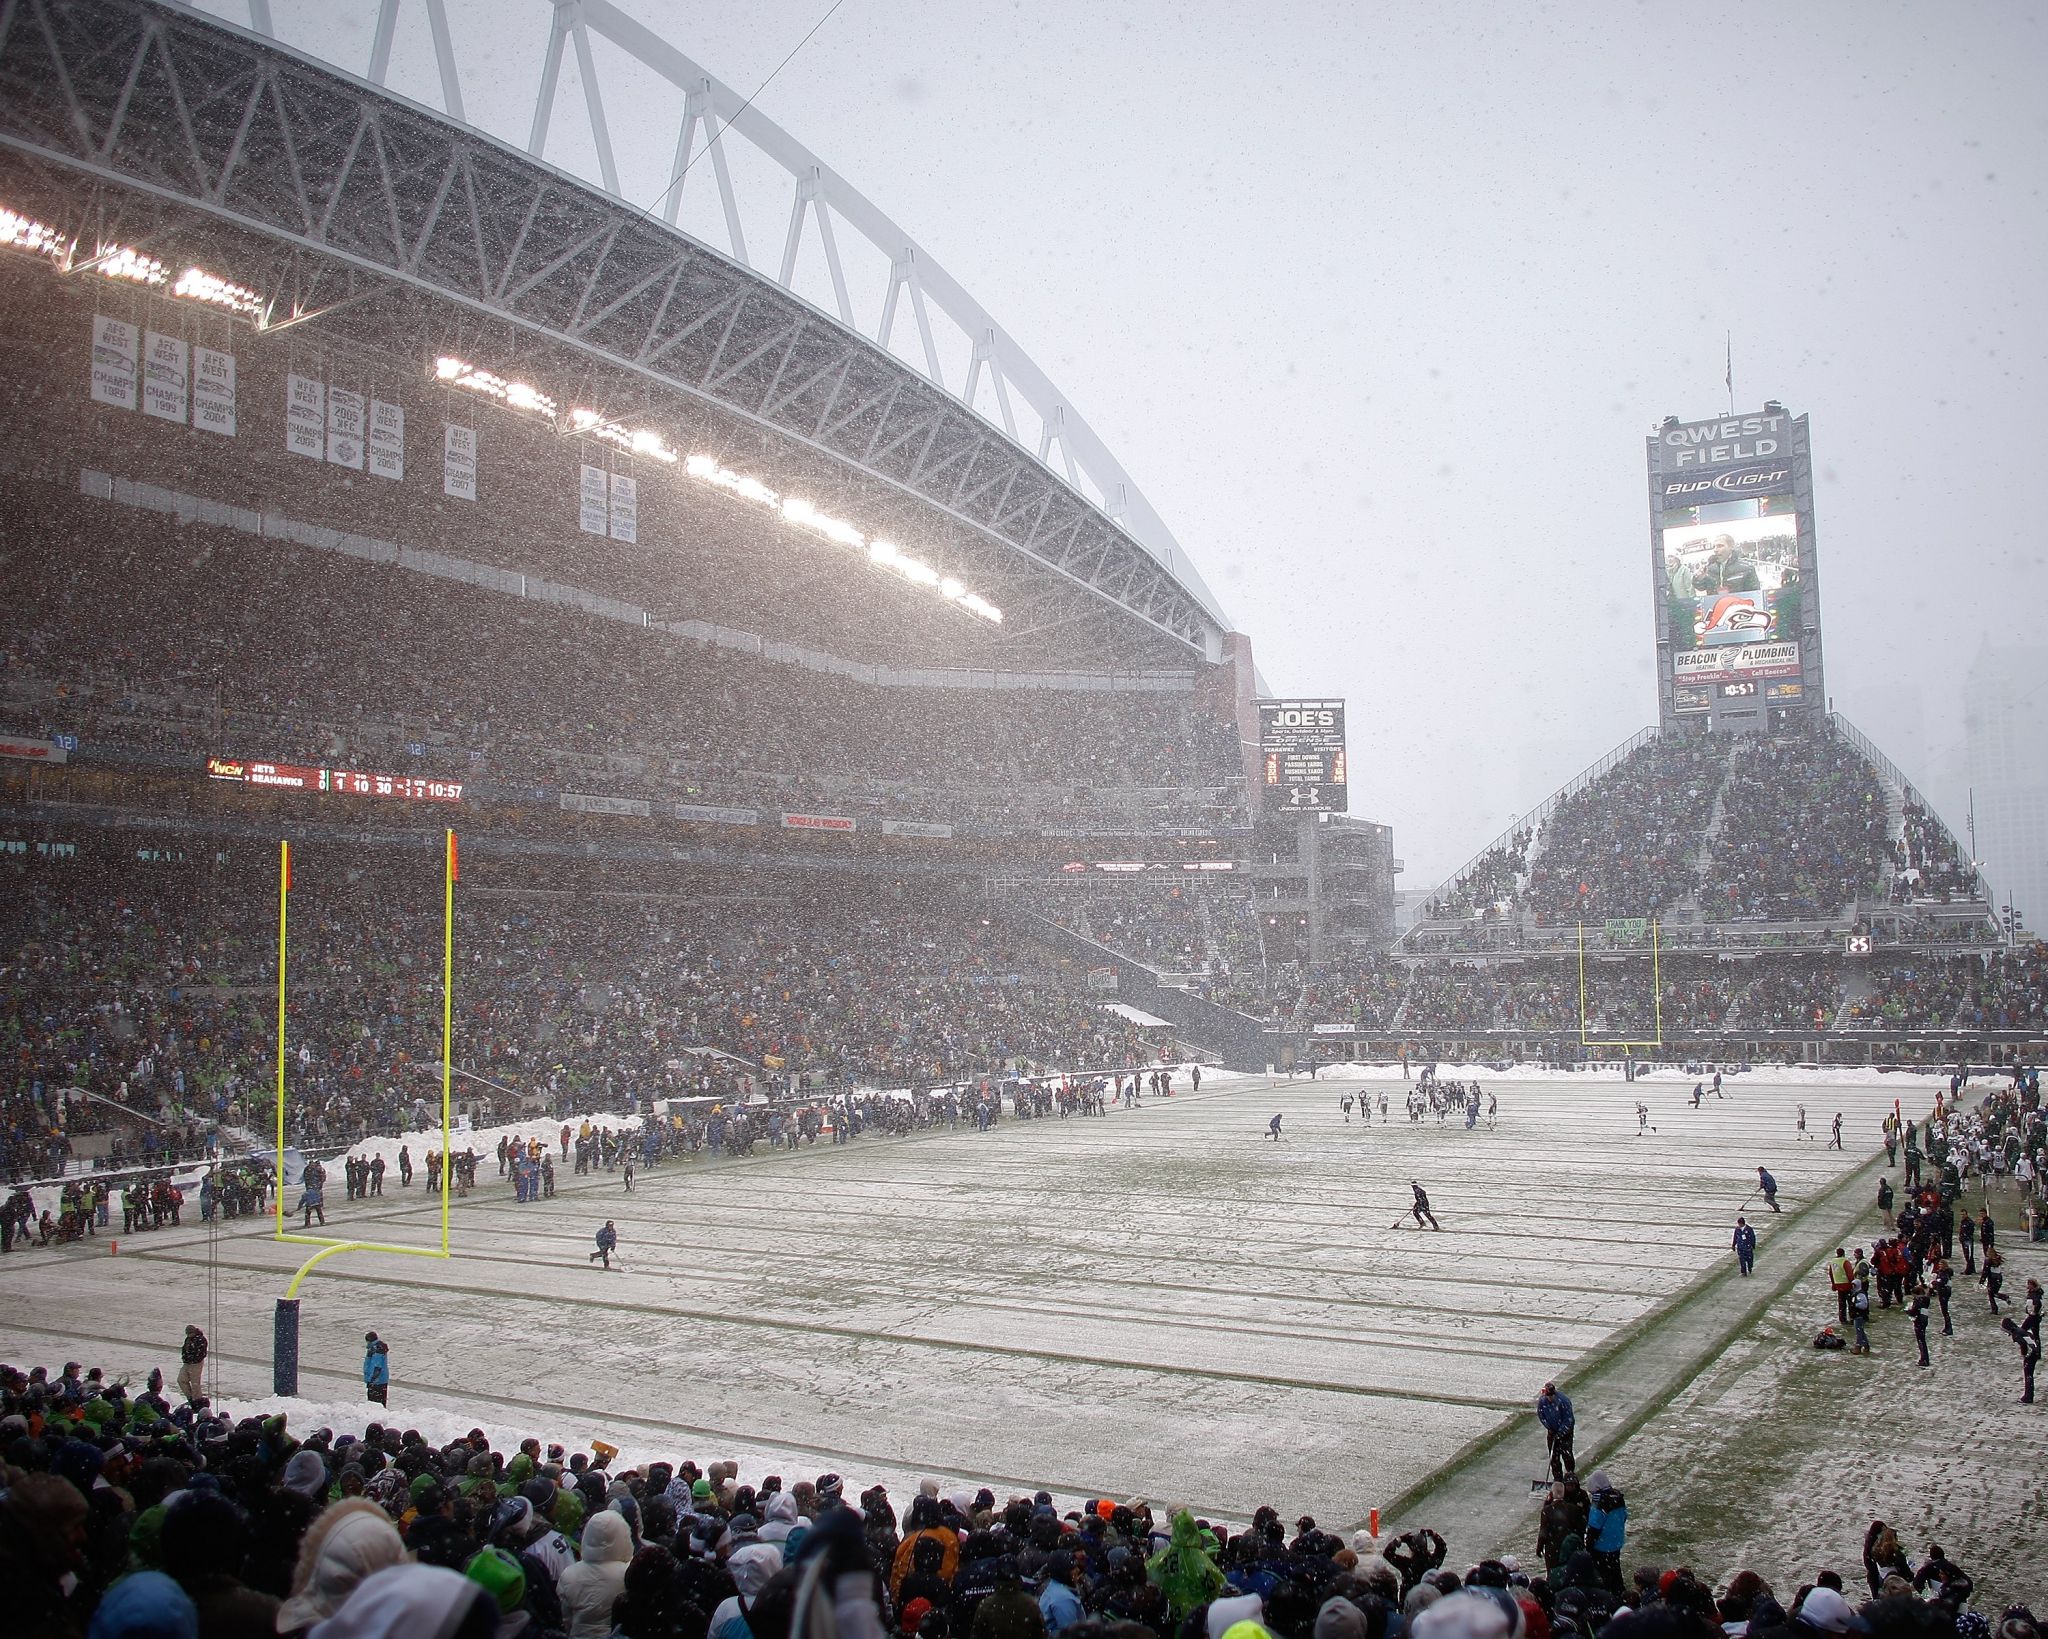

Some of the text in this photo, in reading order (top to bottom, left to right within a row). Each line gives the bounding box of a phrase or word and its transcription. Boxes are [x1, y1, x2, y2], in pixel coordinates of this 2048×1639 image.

[102, 333, 129, 348] WEST
[155, 348, 180, 363] WEST
[202, 363, 228, 379] WEST
[94, 370, 135, 391] CHAMPS
[146, 386, 185, 405] CHAMPS
[294, 390, 318, 404] WEST
[196, 397, 235, 416] CHAMPS
[334, 406, 359, 423] 2005
[377, 414, 398, 429] WEST
[288, 422, 322, 440] CHAMPS
[1666, 415, 1785, 447] QWEST
[370, 446, 403, 462] CHAMPS
[1676, 439, 1777, 466] FIELD
[445, 467, 475, 483] CHAMPS
[1666, 471, 1788, 495] BUD LIGHT
[1677, 646, 1795, 666] BEACON PLUMBING
[1271, 710, 1334, 726] JOE'S
[58, 735, 72, 749] 12
[252, 764, 325, 780] JETS 3
[251, 774, 303, 787] SEAHAWKS
[318, 780, 325, 789] 0
[336, 778, 344, 789] 1
[354, 780, 369, 792] 10
[377, 782, 392, 794] 30
[405, 779, 411, 787] 3
[405, 788, 411, 797] 3
[417, 788, 423, 797] 2
[428, 783, 463, 798] 10:57
[1607, 919, 1626, 929] THANK
[1849, 937, 1869, 952] 25
